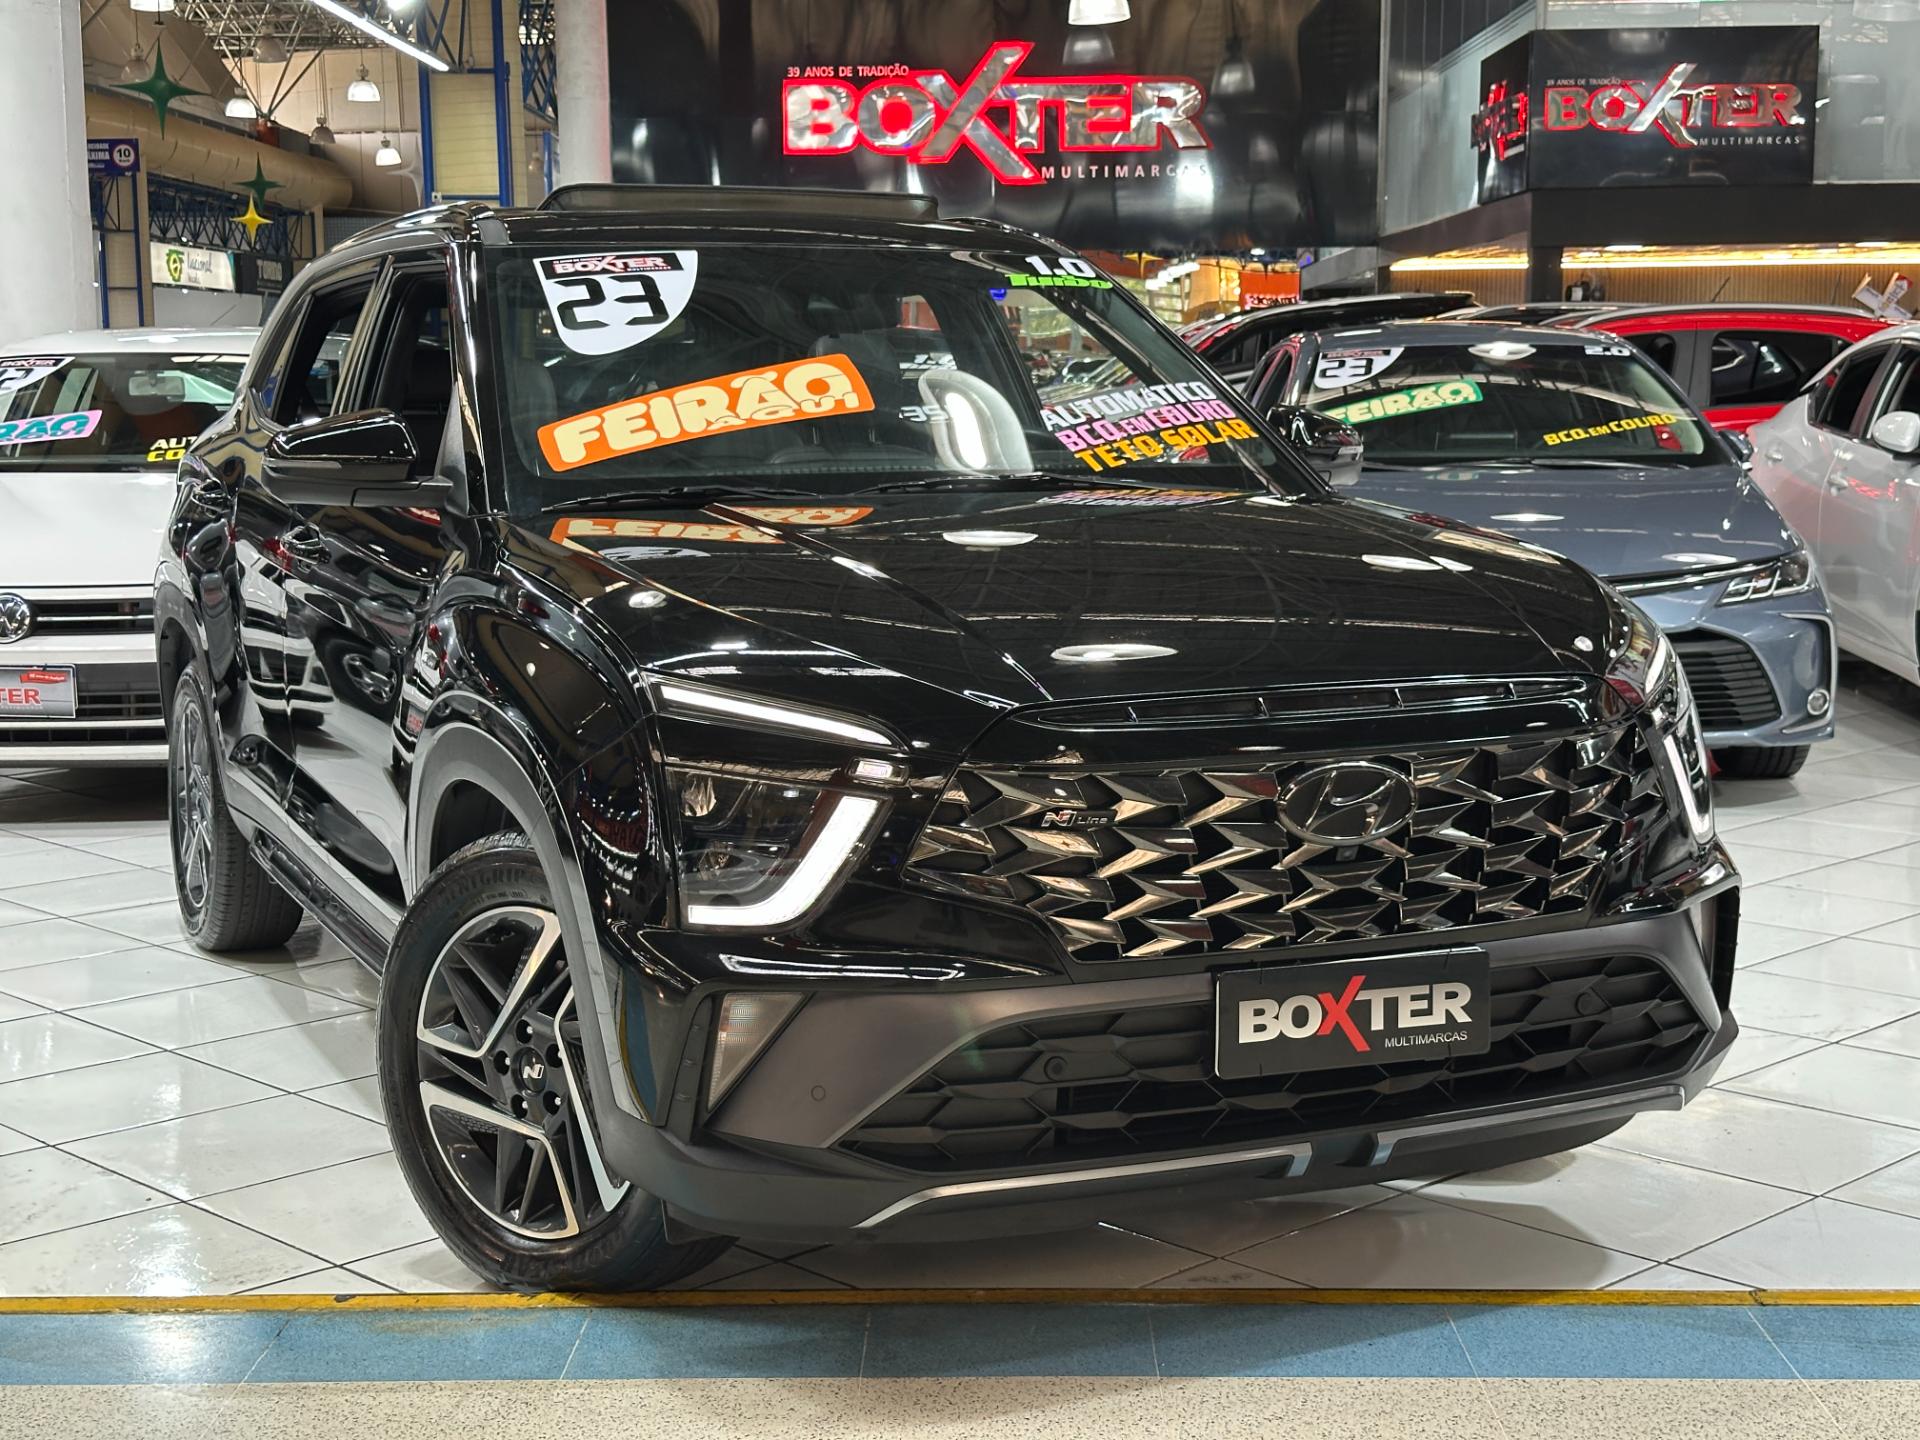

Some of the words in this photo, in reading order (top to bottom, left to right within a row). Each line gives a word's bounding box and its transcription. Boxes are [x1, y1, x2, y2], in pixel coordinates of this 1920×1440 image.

[787, 66, 800, 77] 39
[804, 66, 834, 77] ANOS
[838, 66, 853, 77] DE
[857, 63, 909, 78] TRADIÇÃO
[783, 40, 1213, 185] BOXTER
[1544, 63, 1805, 148] BOXTER
[1700, 135, 1801, 146] MULTIMARCAS
[117, 148, 131, 158] 10
[1042, 164, 1208, 178] MULTIMARCAS
[553, 255, 669, 274] BOXTER
[1025, 255, 1096, 278] 1.0
[553, 274, 669, 331] 23
[1584, 345, 1631, 357] 2.0
[1318, 357, 1374, 379] 23
[553, 362, 853, 463] FEIRÃO
[1325, 382, 1477, 423] FEIRÃO
[1120, 418, 1150, 435] EM
[1145, 400, 1236, 429] COURO
[1587, 424, 1612, 437] EM
[1609, 414, 1678, 432] COURO
[1075, 434, 1164, 473] TETO
[1160, 419, 1259, 450] SOLAR
[1077, 816, 1108, 825] Line
[1238, 975, 1473, 1052] BOXTER
[1384, 1030, 1468, 1048] MULTIMARCAS
